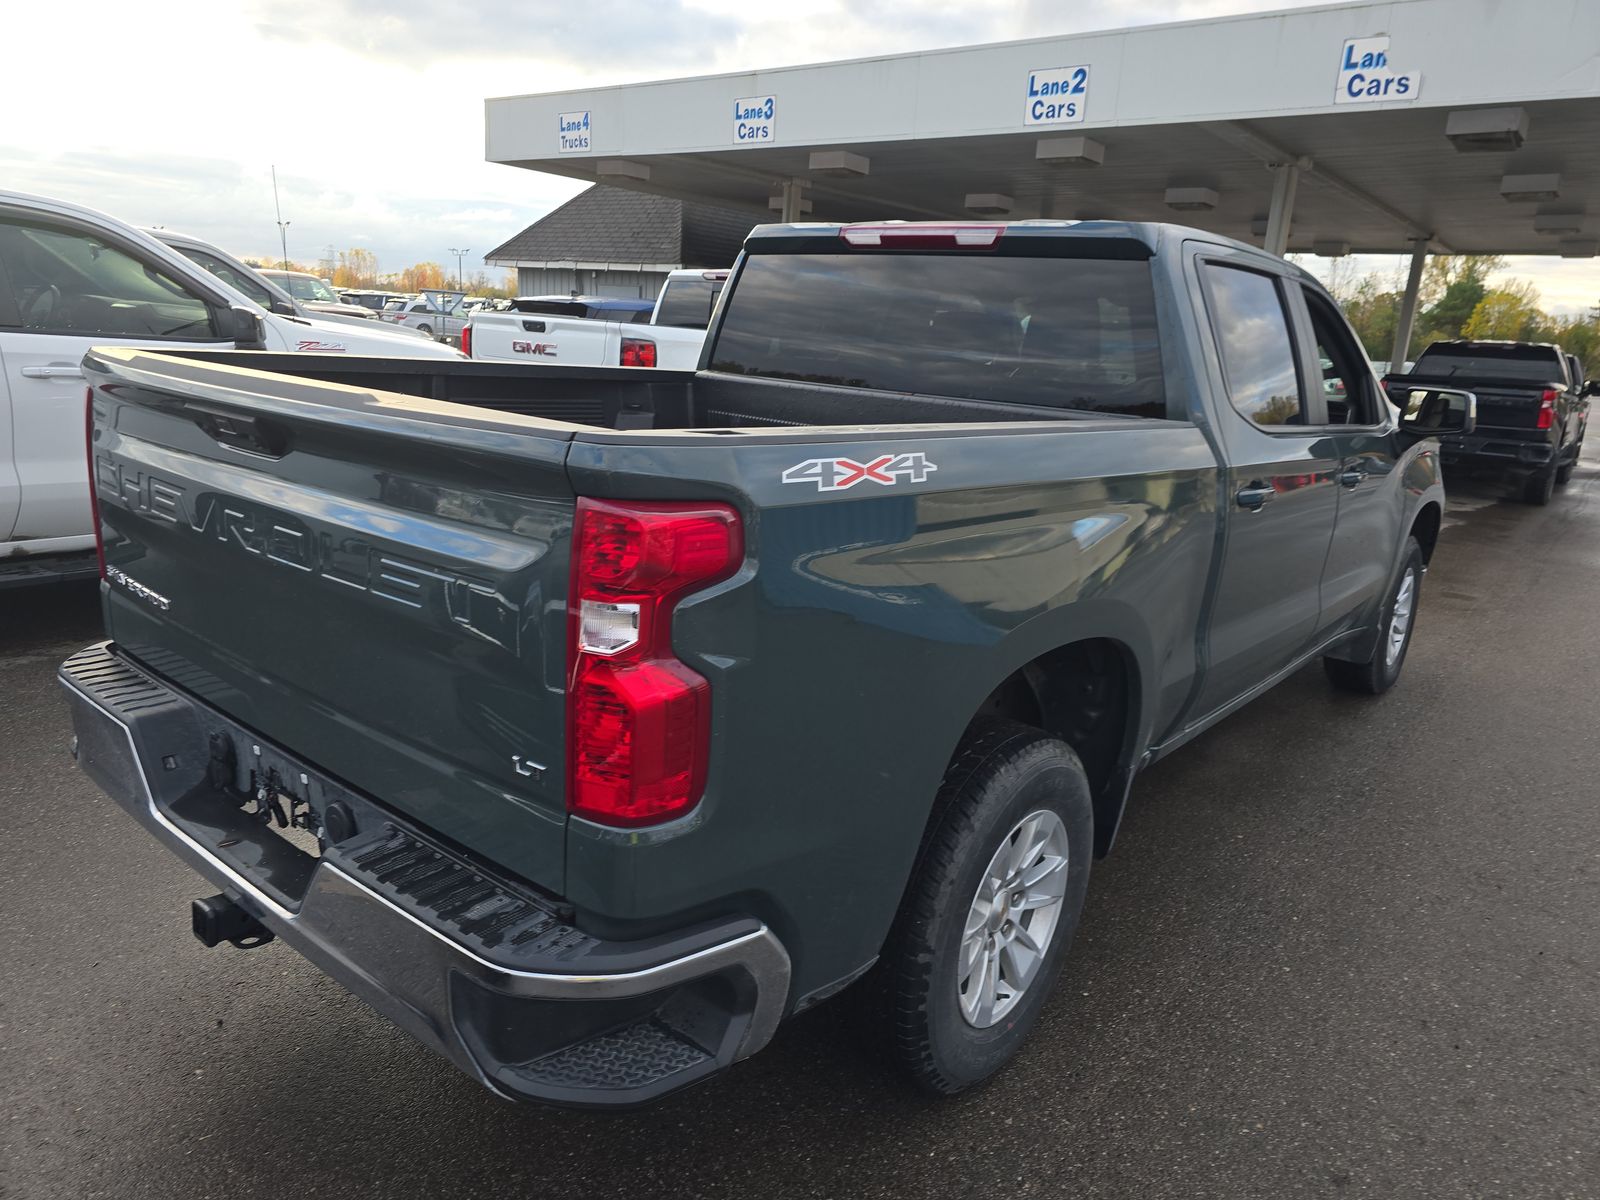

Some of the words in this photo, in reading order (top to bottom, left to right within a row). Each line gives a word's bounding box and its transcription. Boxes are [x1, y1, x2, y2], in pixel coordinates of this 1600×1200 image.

[1343, 44, 1387, 70] Lan
[1028, 75, 1069, 97] Lane
[1070, 68, 1087, 95] 2
[1347, 73, 1410, 97] Cars
[735, 102, 763, 120] Lane
[764, 98, 774, 120] 3
[1031, 100, 1076, 120] Cars
[560, 116, 582, 131] Lane
[582, 112, 589, 130] 4
[738, 123, 769, 139] Cars
[561, 135, 589, 149] Trucks
[512, 340, 558, 357] GMC
[96, 454, 497, 626] CHEVROLET
